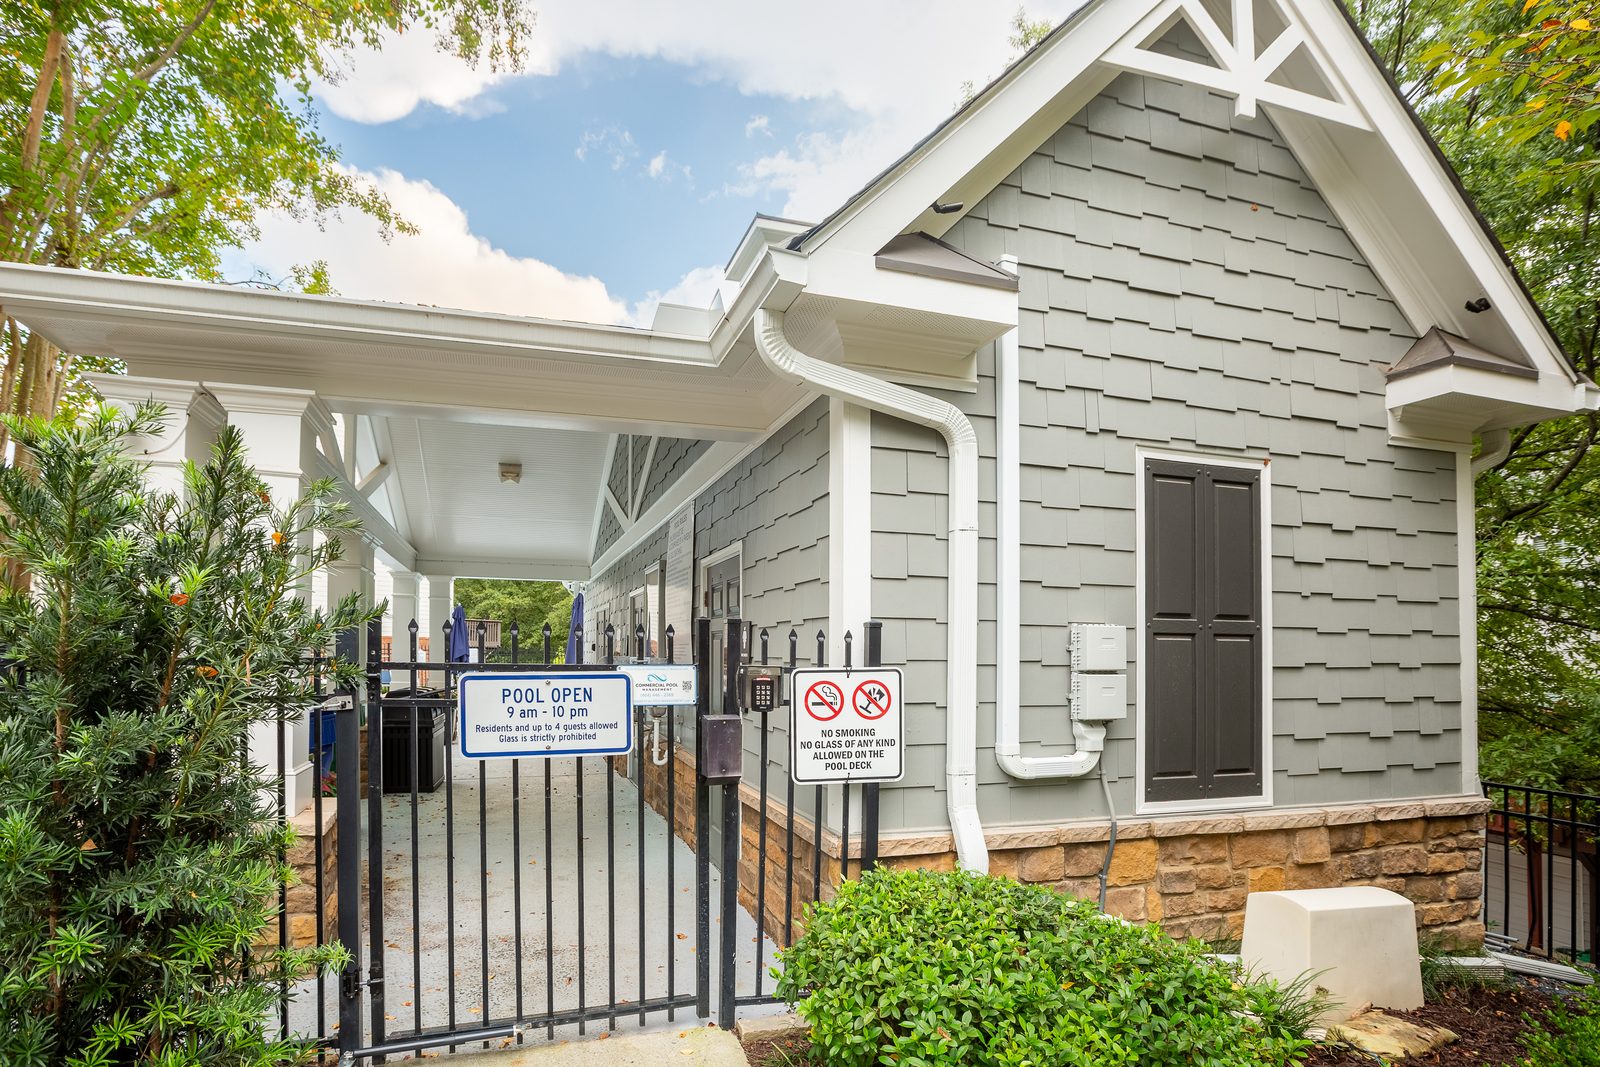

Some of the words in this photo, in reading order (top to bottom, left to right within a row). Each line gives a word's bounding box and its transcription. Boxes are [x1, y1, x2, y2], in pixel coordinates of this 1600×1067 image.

[502, 688, 545, 704] POOL
[551, 687, 592, 702] OPEN
[507, 706, 515, 718] 9
[519, 708, 538, 718] am
[552, 705, 565, 717] 10
[570, 707, 588, 719] pm
[475, 724, 513, 733] Residents
[515, 723, 530, 732] and
[532, 724, 542, 733] up
[544, 723, 553, 731] to
[555, 722, 560, 730] 4
[563, 722, 587, 732] guests
[589, 722, 618, 730] allowed
[821, 729, 833, 738] NO
[835, 728, 876, 737] SMOKING
[499, 734, 519, 743] Glass
[521, 734, 528, 742] is
[530, 733, 556, 742] strictly
[558, 732, 597, 742] prohibited
[800, 741, 813, 749] NO
[814, 740, 843, 749] GLASS
[844, 739, 856, 748] OF
[856, 739, 874, 748] ANY
[875, 738, 896, 747] KIND
[813, 751, 853, 760] ALLOWED
[854, 750, 867, 758] ON
[868, 749, 885, 758] THE
[825, 762, 848, 771] POOL
[849, 761, 872, 770] DECK
